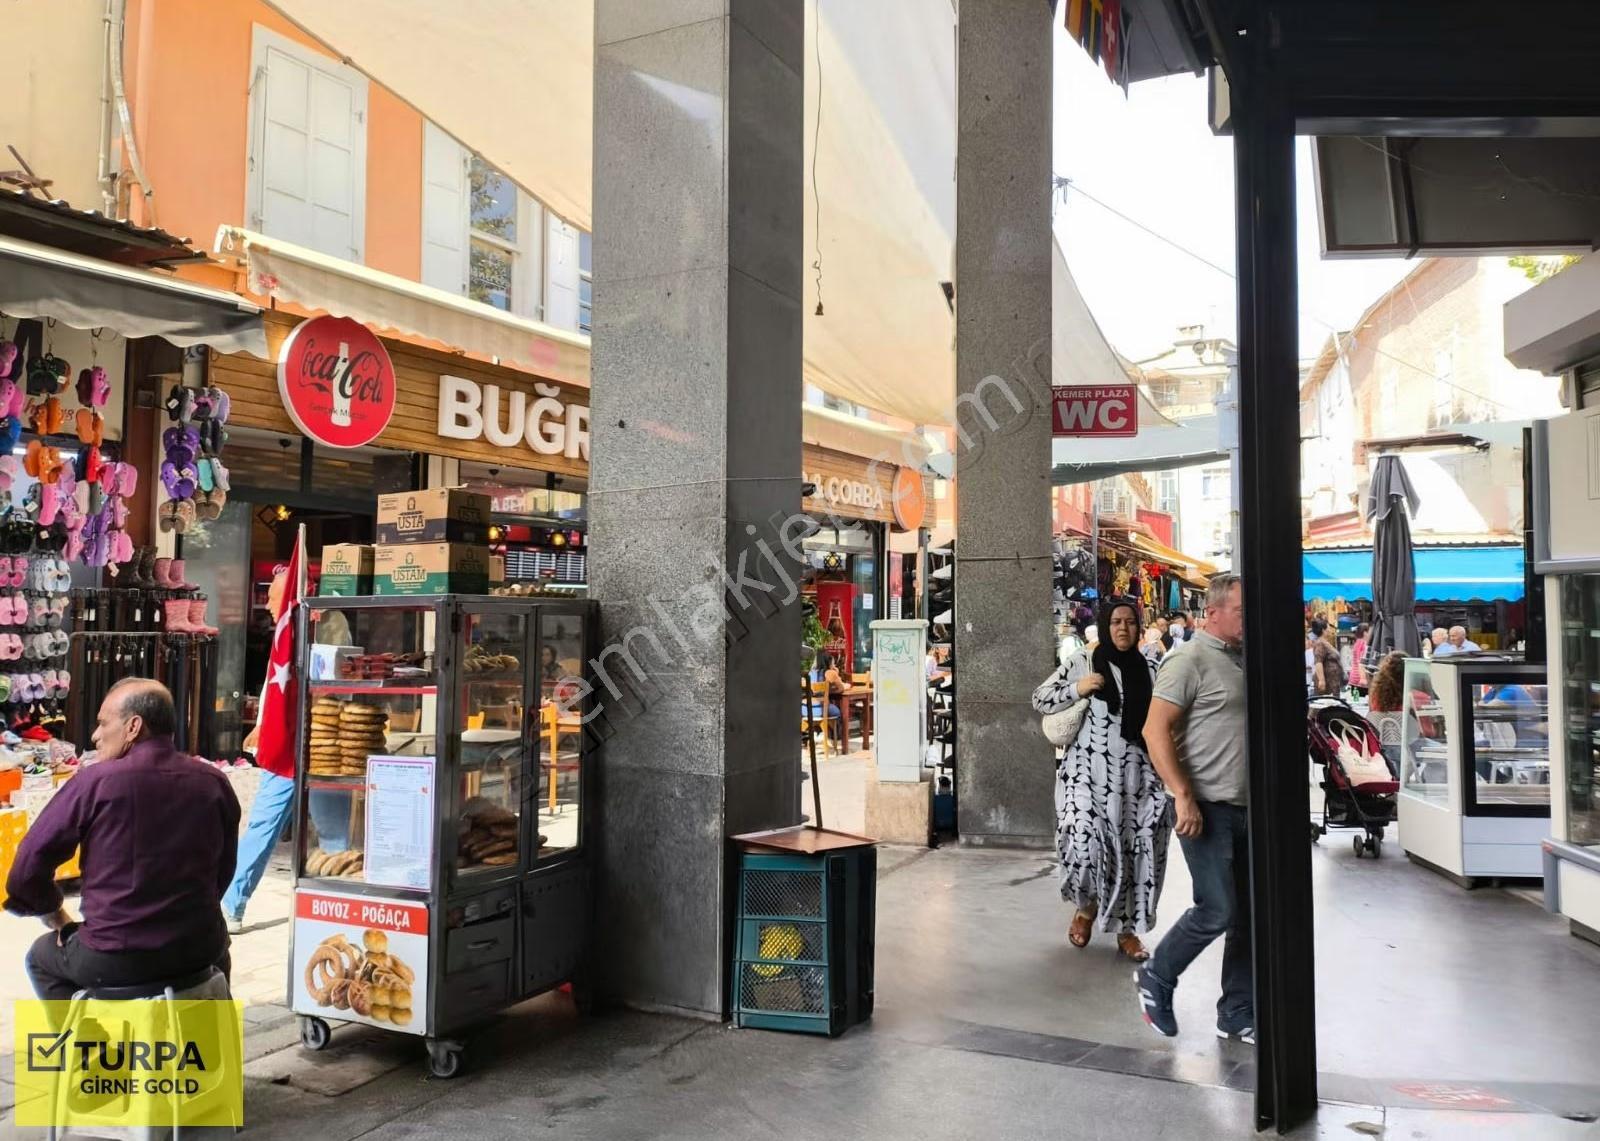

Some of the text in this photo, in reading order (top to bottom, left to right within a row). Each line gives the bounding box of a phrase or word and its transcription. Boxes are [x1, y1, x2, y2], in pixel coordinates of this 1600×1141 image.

[1054, 389, 1130, 399] KEMER PLAZA
[1057, 399, 1128, 430] WC
[823, 476, 884, 510] ÇORBA
[397, 515, 424, 529] USTA
[393, 568, 426, 581] USTAM
[312, 899, 350, 919] BOYOZ
[361, 904, 410, 930] POĞAÇA
